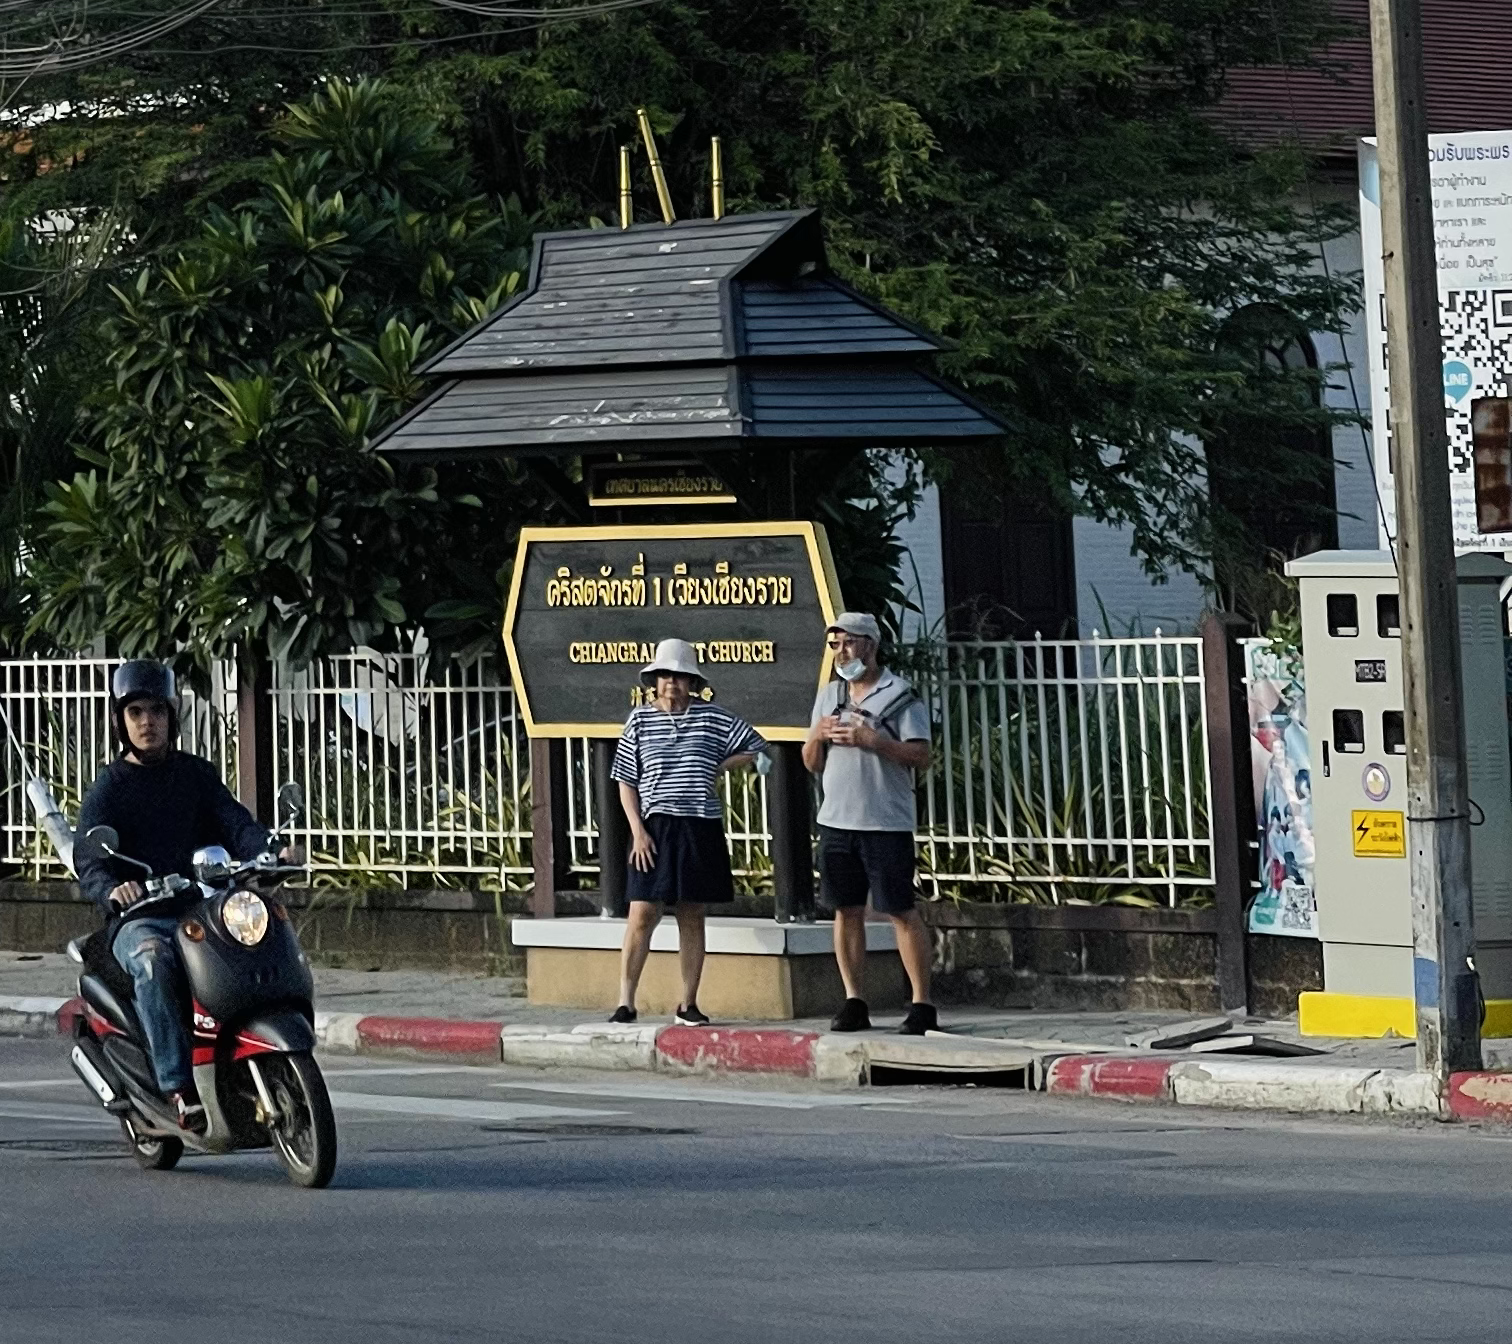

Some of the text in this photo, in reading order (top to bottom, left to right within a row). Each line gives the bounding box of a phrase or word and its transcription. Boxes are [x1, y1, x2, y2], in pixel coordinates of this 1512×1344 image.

[1443, 373, 1468, 387] LINE
[546, 552, 792, 606] คริสตจักรที่ 1 เวียงเชียงราย
[569, 641, 656, 663] CHIANGRAI
[707, 640, 774, 663] CHURCH
